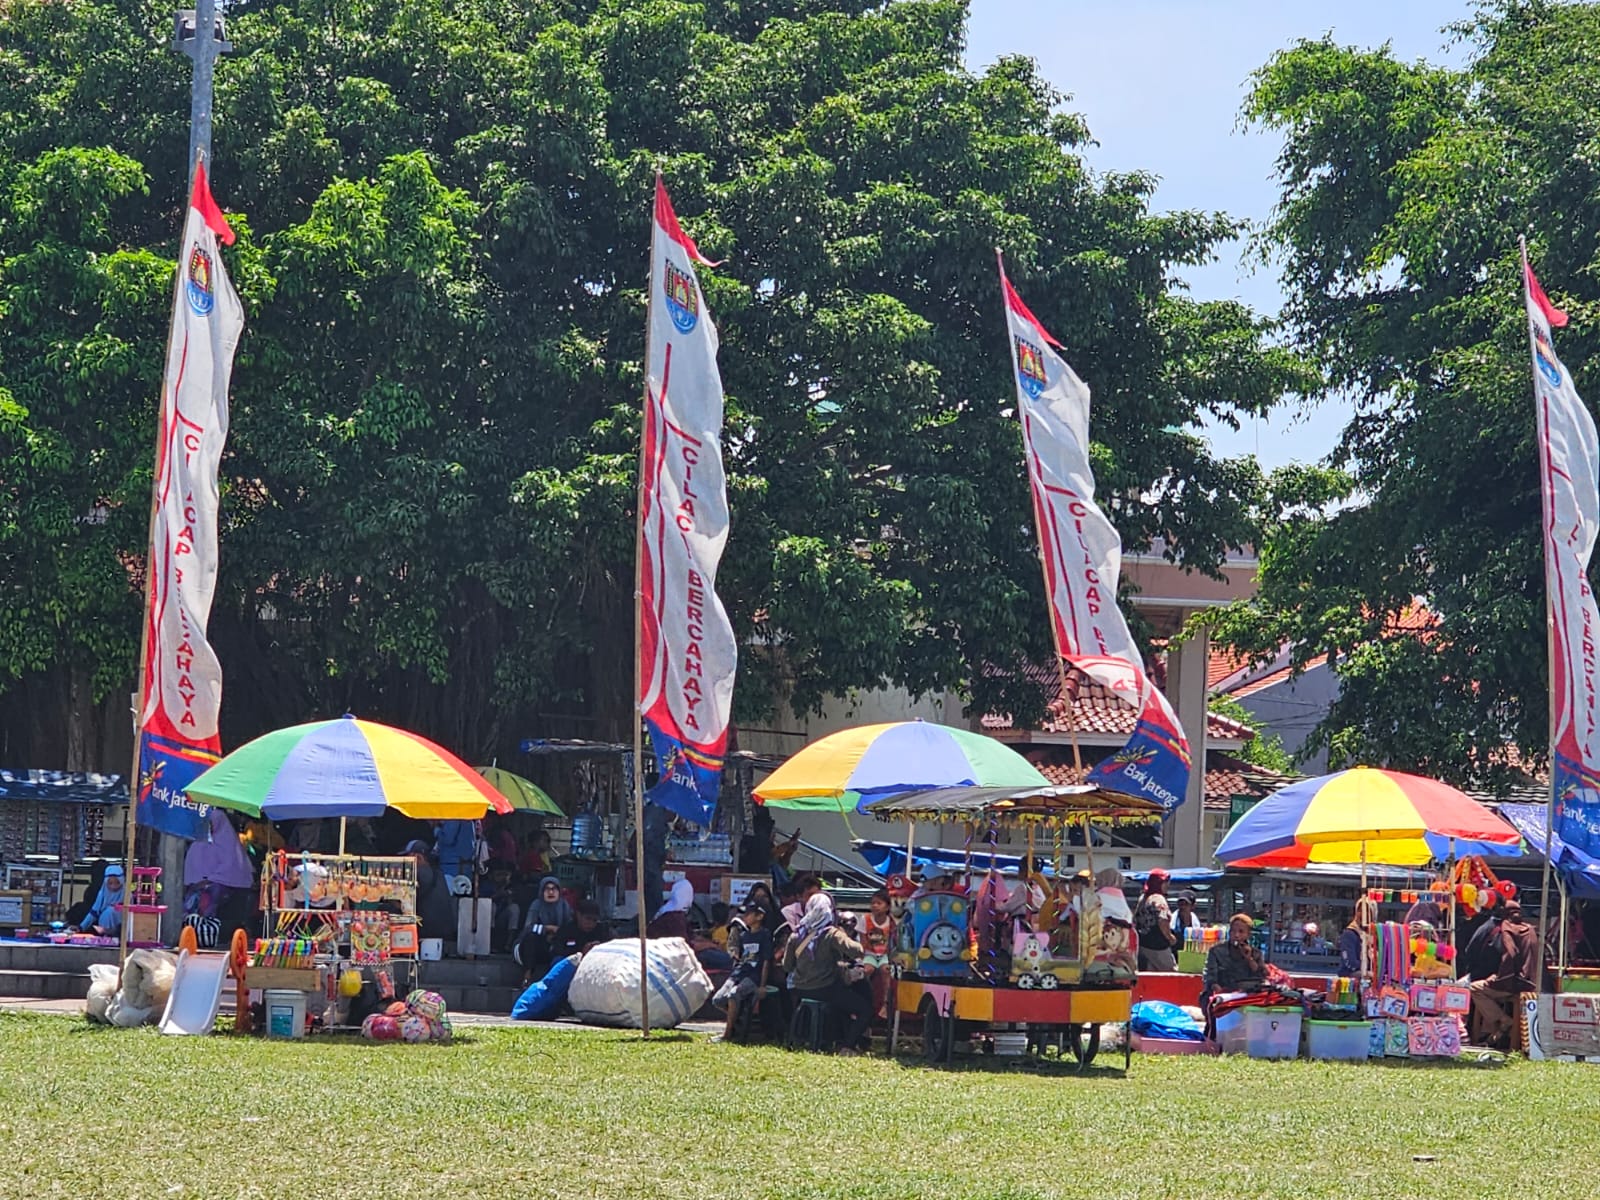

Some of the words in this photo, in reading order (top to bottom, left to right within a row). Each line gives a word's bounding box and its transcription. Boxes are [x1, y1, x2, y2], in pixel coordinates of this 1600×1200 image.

[174, 434, 200, 556] CICAP
[675, 446, 700, 560] CILAC
[175, 566, 196, 727] BAHAYA
[682, 568, 705, 731] BERCAHAYA
[1140, 775, 1179, 808] Jateng
[1569, 1008, 1586, 1019] jam
